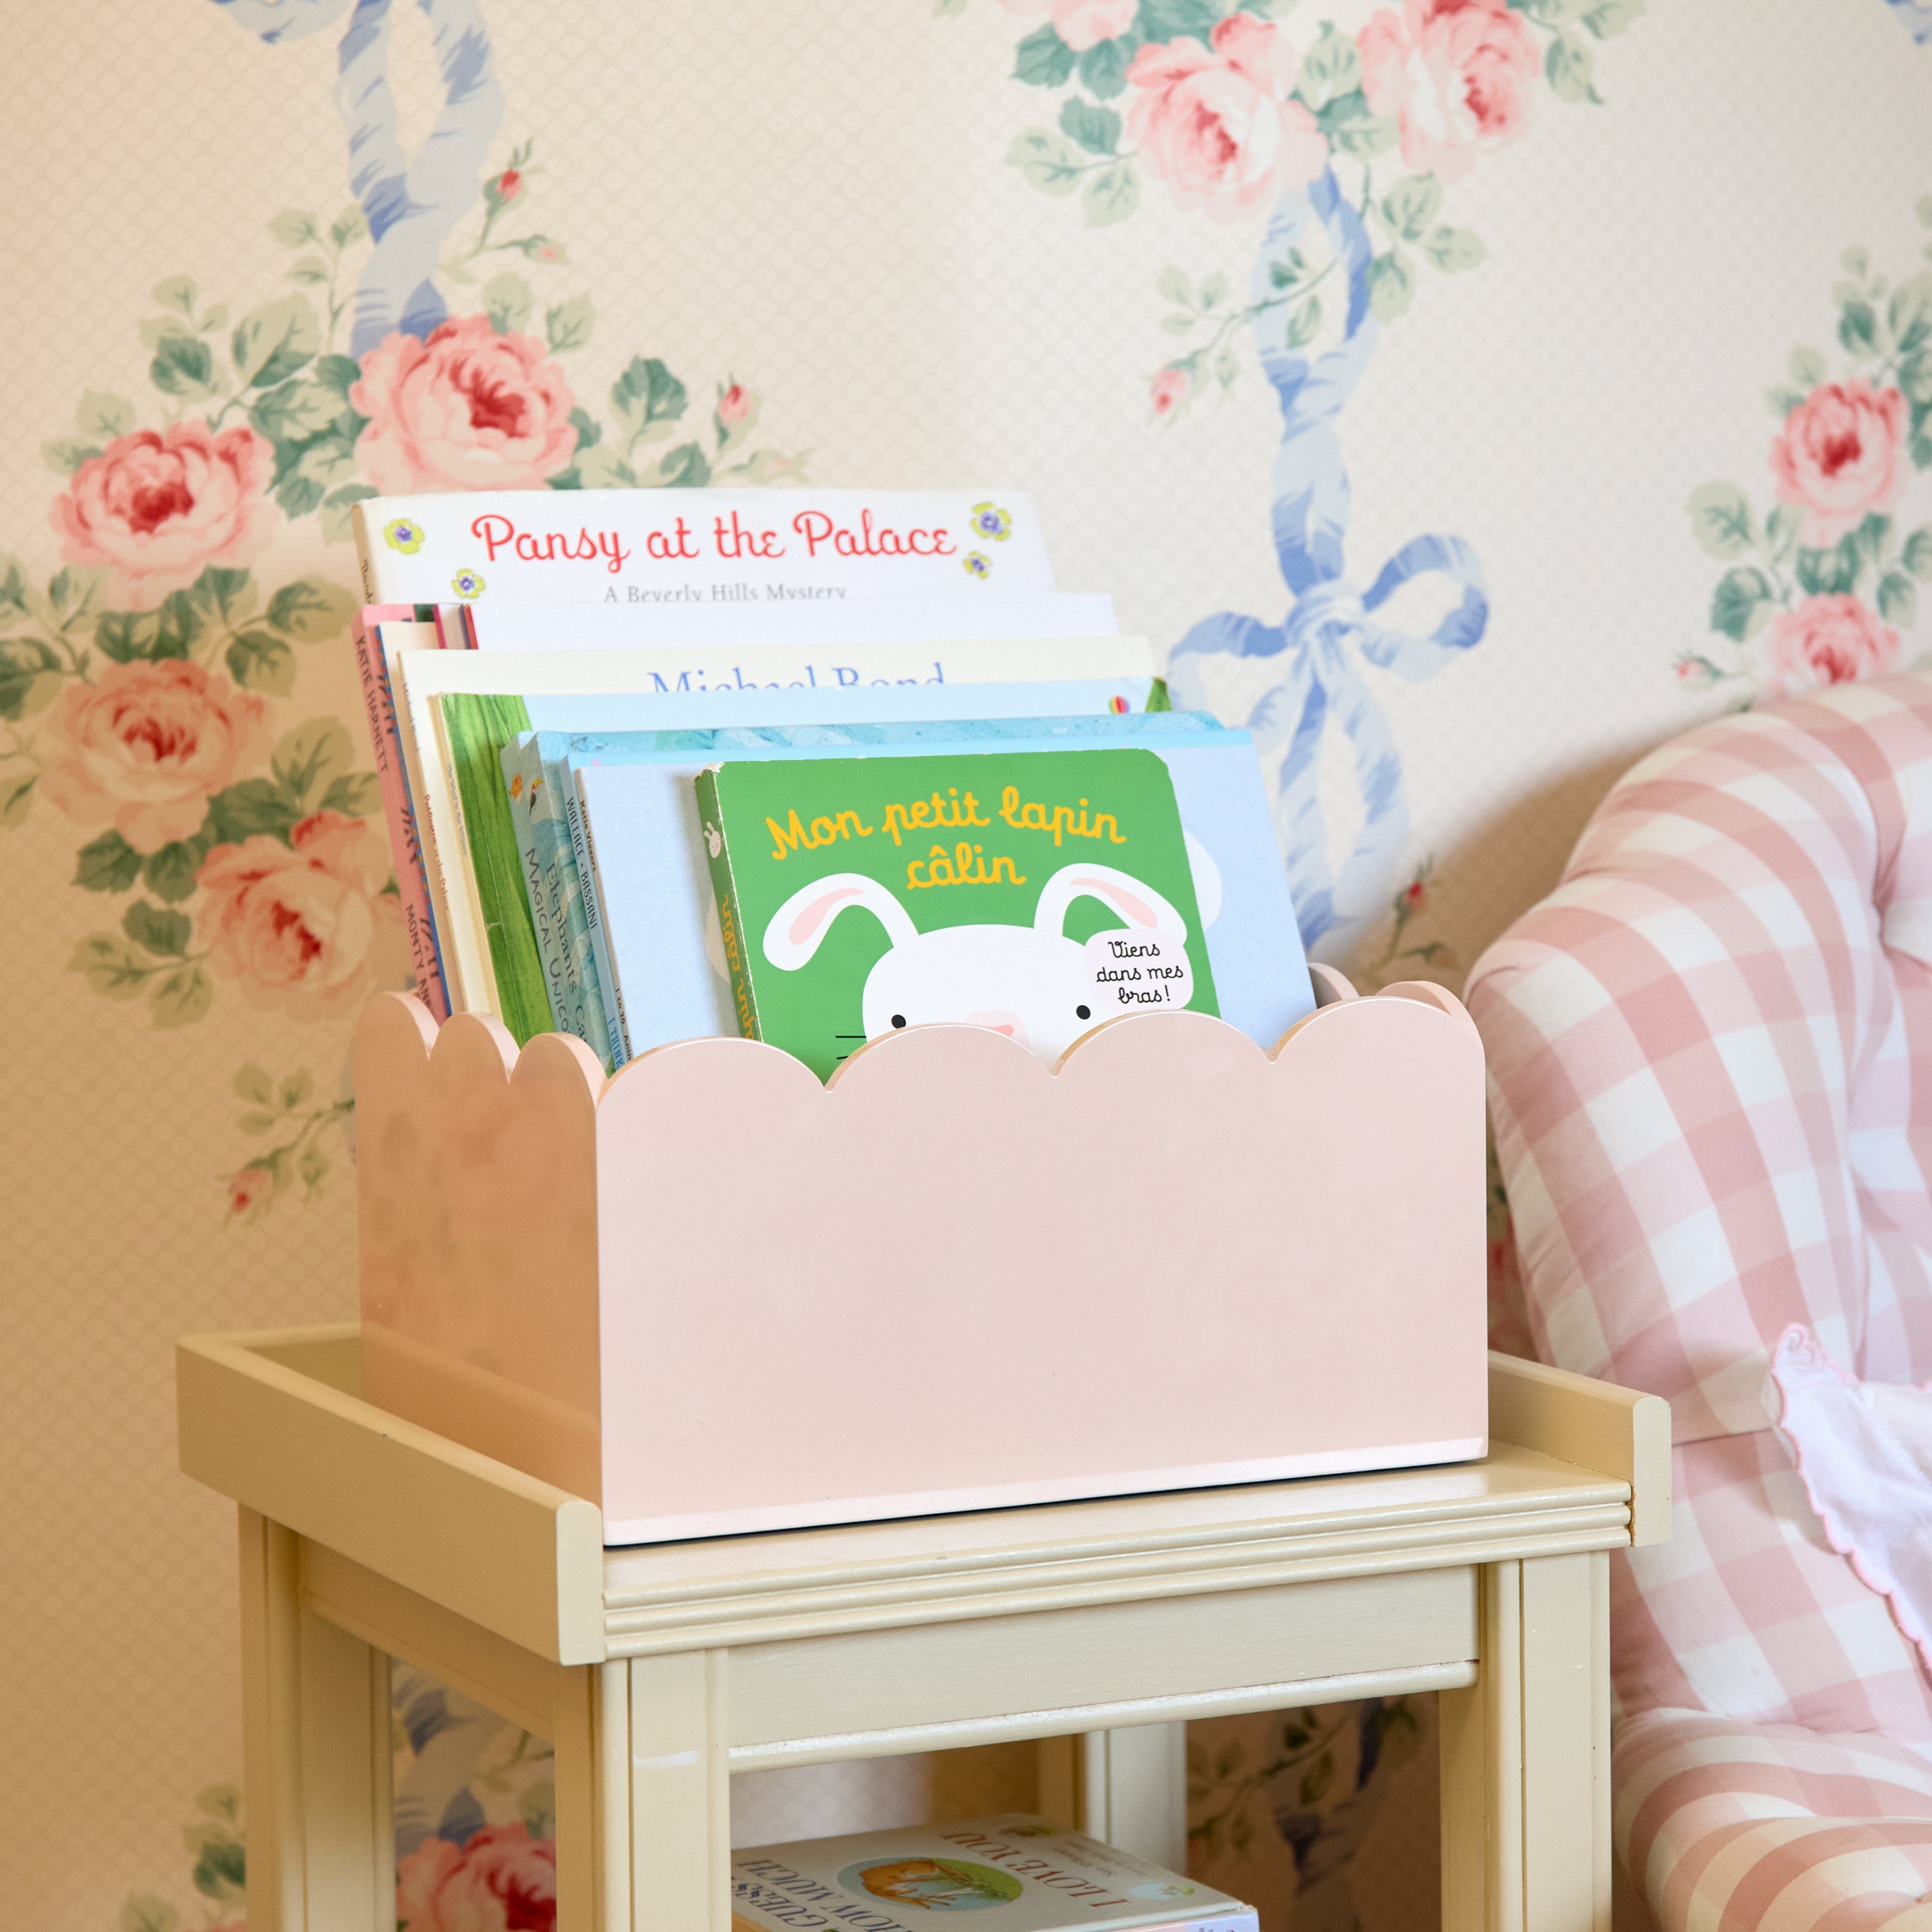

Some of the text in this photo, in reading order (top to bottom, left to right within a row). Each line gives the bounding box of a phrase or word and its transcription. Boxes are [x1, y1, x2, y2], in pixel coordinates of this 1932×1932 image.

[471, 508, 957, 573] Pansy at the Palace
[604, 582, 847, 602] A Beverly Hills Mystery
[356, 635, 388, 772] KATIE HARNETT
[765, 786, 1127, 860] Mon petit lapin
[566, 797, 597, 930] WALLACE BASSANI
[907, 841, 1026, 889] câlin
[405, 904, 424, 970] MONTY
[525, 847, 570, 1033] MAGICAL UNICO
[546, 862, 588, 1043] Elephants Ca
[722, 894, 742, 972] câlin
[1108, 941, 1160, 958] Viens
[1096, 965, 1184, 982] dans mes
[1118, 984, 1170, 1004] bras!
[619, 1011, 626, 1024] 20
[608, 1016, 624, 1070] I THINK
[940, 1833, 1022, 1862] YOU
[736, 1859, 844, 1902] MUCH
[1005, 1859, 1113, 1898] LOVE
[734, 1882, 828, 1927] GUESS
[1089, 1898, 1132, 1909] I
